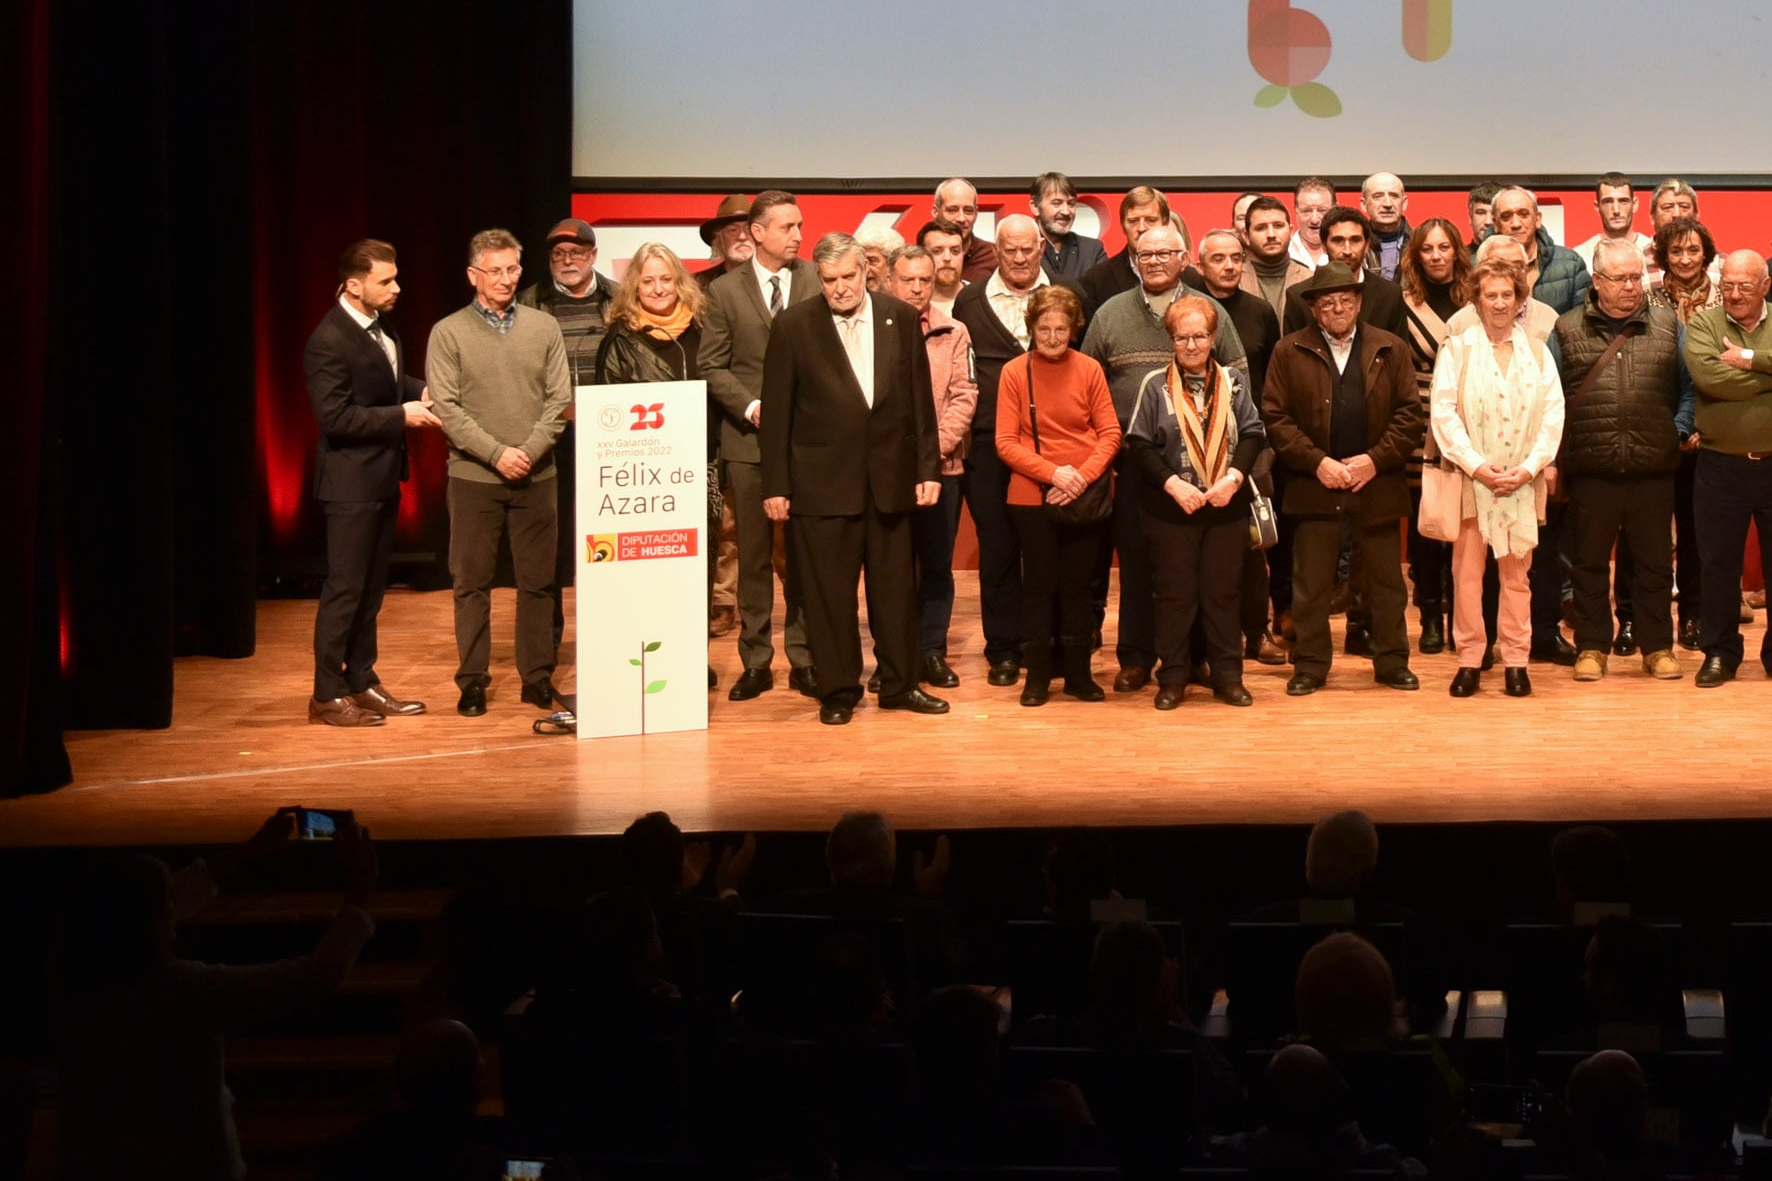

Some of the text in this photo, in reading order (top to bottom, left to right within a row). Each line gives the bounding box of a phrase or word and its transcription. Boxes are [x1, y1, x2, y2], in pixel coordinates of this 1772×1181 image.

[615, 437, 660, 449] Galardón
[597, 445, 672, 460] y Premios 2022
[599, 461, 694, 488] Félix de
[598, 493, 676, 516] Azara
[621, 531, 688, 546] DIPUTACIÓN
[621, 544, 688, 558] DE HUESCA
